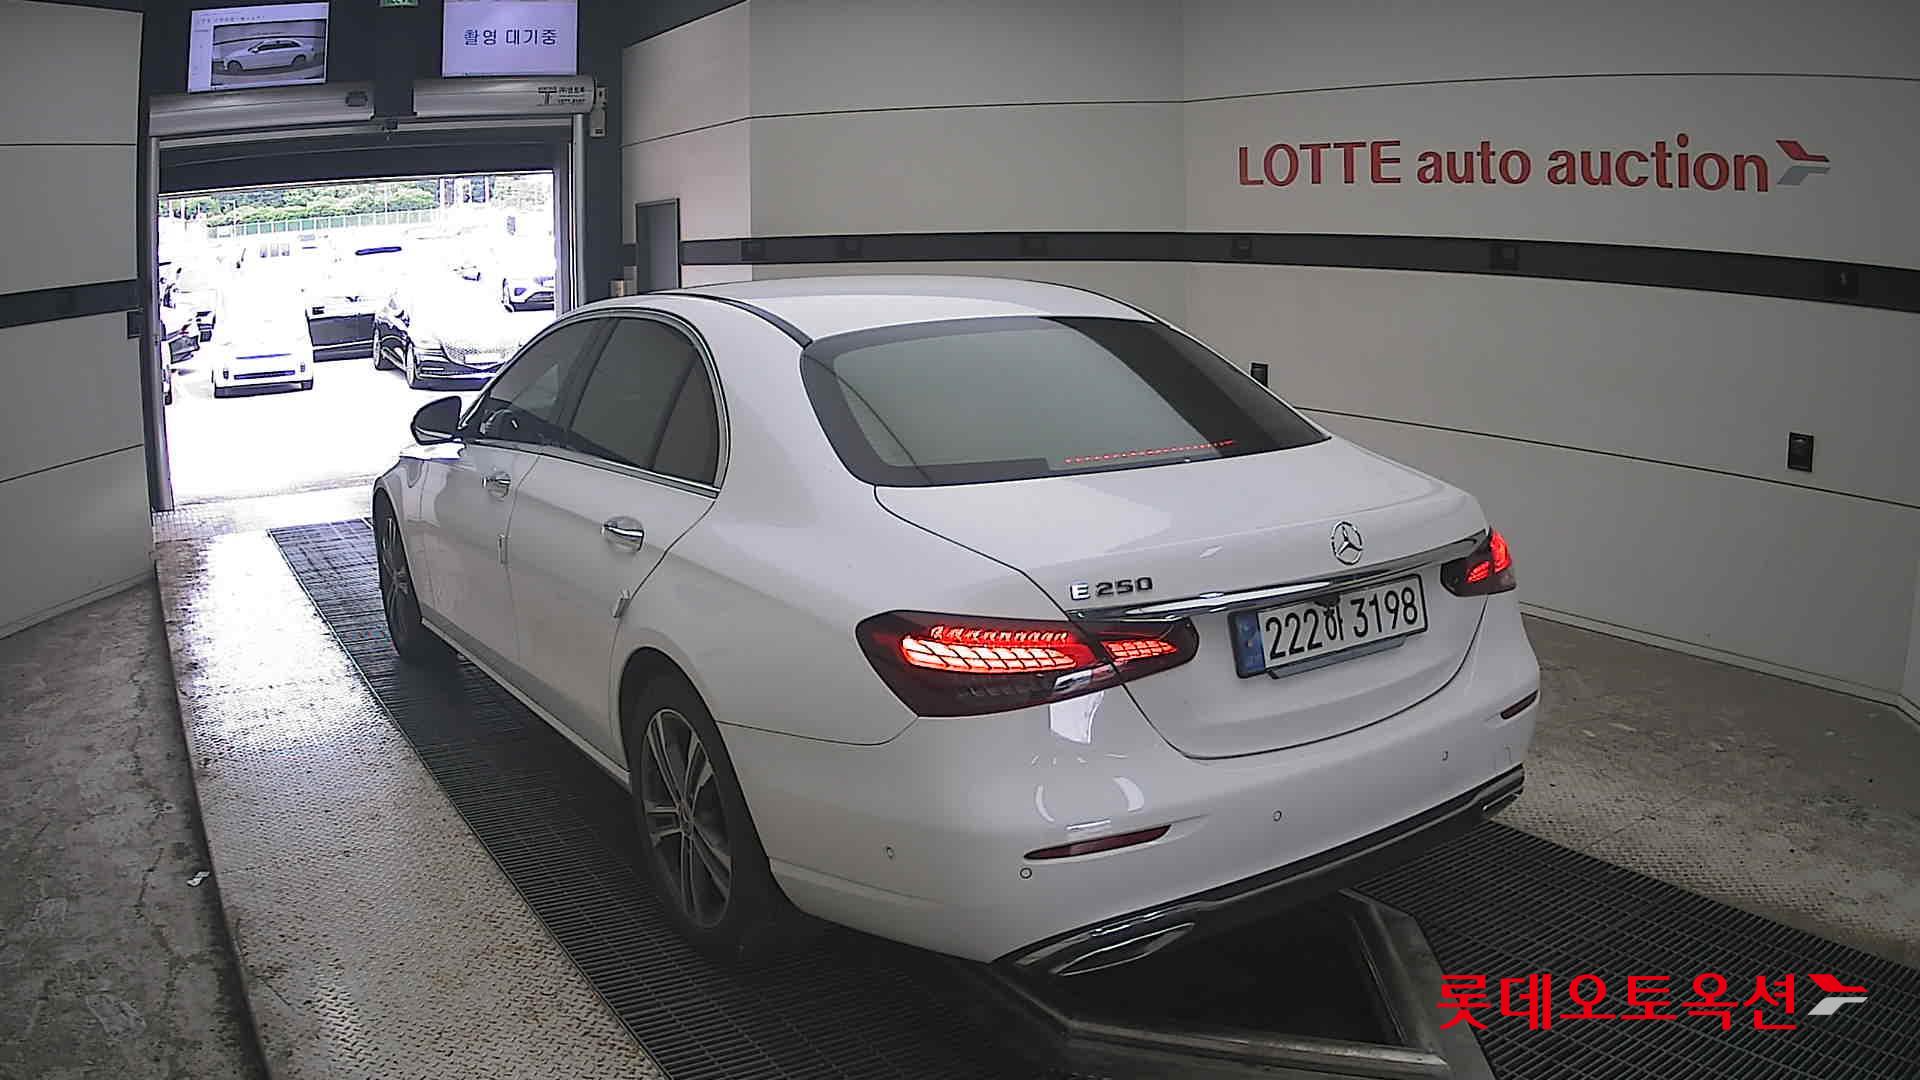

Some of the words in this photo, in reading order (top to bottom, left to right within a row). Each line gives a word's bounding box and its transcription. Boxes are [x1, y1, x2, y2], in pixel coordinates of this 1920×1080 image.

[464, 29, 497, 46] 촬영
[505, 29, 557, 46] 대기중
[1239, 140, 1401, 187] LOTTE
[1416, 141, 1532, 185] auto
[1547, 132, 1769, 193] auction
[1070, 582, 1090, 601] E
[1096, 577, 1153, 597] 250
